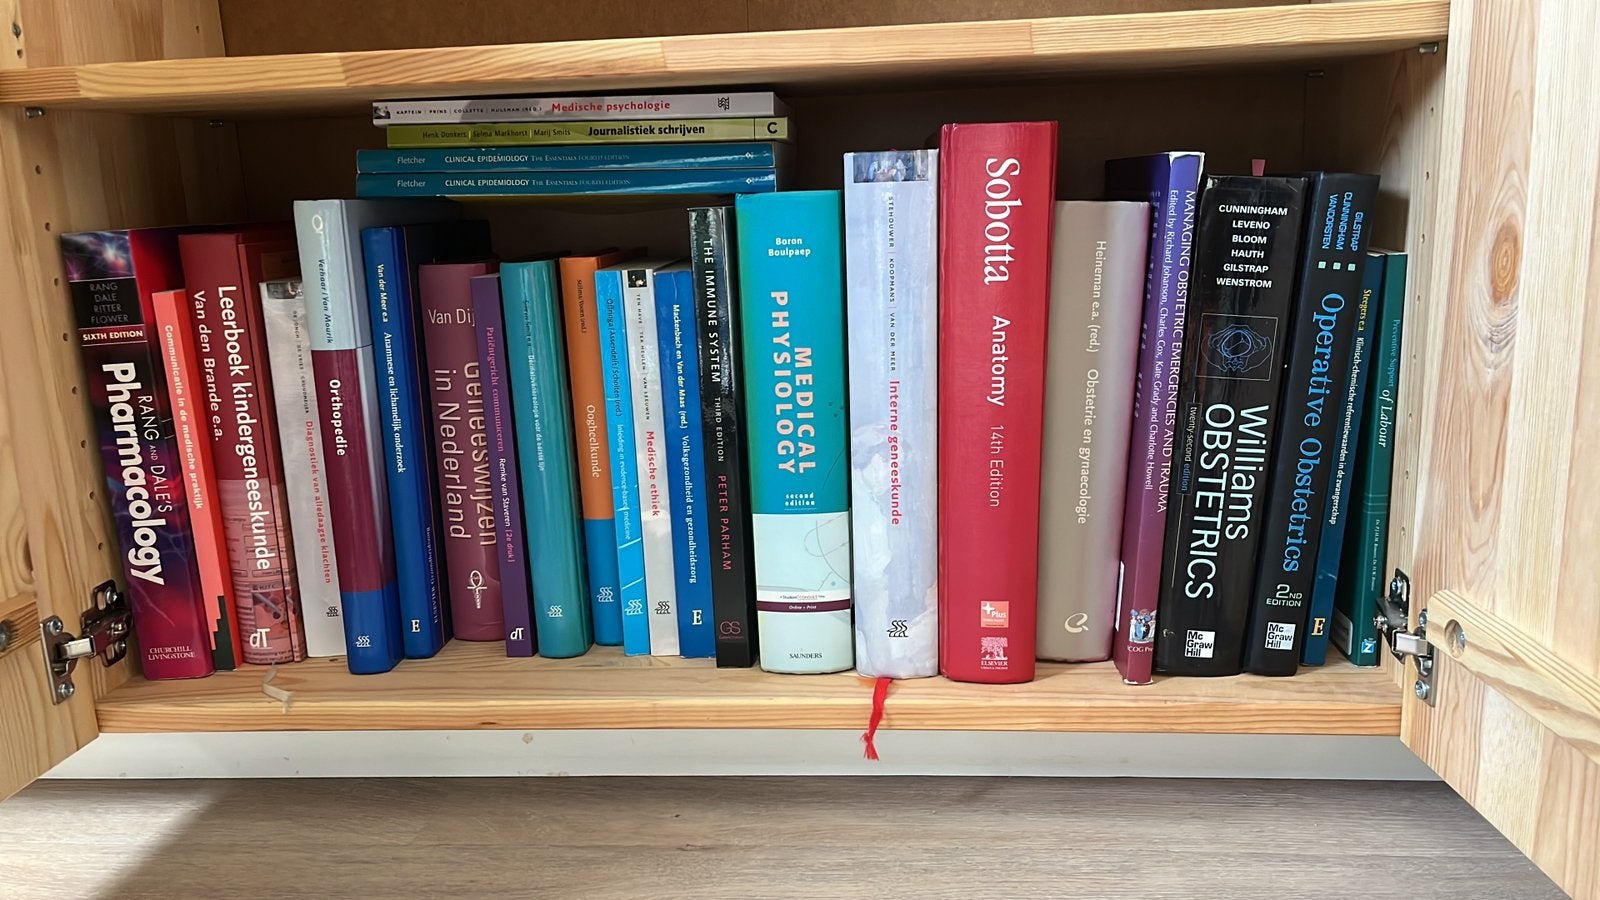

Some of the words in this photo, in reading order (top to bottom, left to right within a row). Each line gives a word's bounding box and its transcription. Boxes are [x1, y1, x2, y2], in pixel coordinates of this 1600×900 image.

[551, 102, 603, 112] Medische
[606, 101, 670, 115] psychologie
[494, 129, 528, 138] Markhorst
[588, 124, 656, 136] Journalistiek
[658, 124, 705, 136] schrijven
[767, 122, 778, 134] C
[396, 156, 426, 164] Fletcher
[477, 154, 528, 163] EPIDEMIOLOGY
[444, 179, 475, 187] CLINICAL
[478, 178, 529, 187] EPIDEMIOLOGY
[1168, 189, 1178, 216] Edited
[1218, 204, 1288, 216] CUNNINGHAM
[1336, 192, 1352, 250] CUNNINGHAM
[984, 158, 1022, 285] Sobotta
[1180, 190, 1196, 268] MANAGING
[1232, 220, 1270, 230] LEVENO
[1232, 234, 1268, 244] BLOOM
[1322, 194, 1338, 249] VANDORSTEN
[1350, 212, 1364, 251] GILSTRAP
[702, 238, 714, 264] THE
[768, 248, 811, 258] Boulpaep
[775, 237, 802, 246] Boron
[1164, 231, 1175, 262] Richard
[1231, 249, 1264, 259] HAUTH
[90, 282, 118, 292] RANG
[1092, 241, 1107, 298] Heineman
[1160, 265, 1173, 306] Johanson,
[1216, 278, 1272, 288] WENSTROM
[1223, 263, 1268, 274] GILSTRAP
[93, 304, 122, 312] RITTER
[94, 292, 117, 302] DALE
[194, 290, 206, 318] Van
[318, 258, 328, 290] Verhaar
[324, 314, 333, 344] Mourik
[704, 270, 718, 326] IMMUNE
[1092, 302, 1100, 321] e.a.
[1172, 270, 1189, 338] OBSTETRIC
[1359, 288, 1372, 320] Steegers
[91, 314, 128, 324] FLOWER
[218, 286, 250, 376] Leerboek
[428, 308, 452, 324] Van
[606, 298, 614, 327] Offringa
[610, 331, 618, 366] Assendelft
[1157, 306, 1168, 338] Charles
[82, 332, 108, 341] SIXTH
[110, 330, 143, 340] EDITION
[198, 325, 212, 352] den
[384, 332, 394, 375] Anamnese
[1086, 324, 1100, 352] (red.)
[1390, 319, 1400, 357] Preventive
[672, 304, 682, 349] Mackenbach
[678, 410, 688, 428] (red.)
[708, 332, 721, 382] SYSTEM
[988, 315, 1011, 406] Anatomy
[1154, 361, 1163, 380] Kate
[1304, 293, 1345, 427] Operative
[1348, 337, 1364, 402] Klinisch-chemische
[1387, 358, 1397, 387] Support
[204, 358, 222, 412] Brande
[434, 369, 457, 391] in
[770, 291, 796, 474] PHYSIOLOGY
[1084, 369, 1098, 426] Obstetrie
[1151, 381, 1162, 406] Grady
[1166, 341, 1182, 426] EMERGENCIES
[1379, 390, 1394, 402] of
[164, 325, 184, 394] Communicatie
[181, 424, 196, 470] medische
[189, 473, 204, 510] praktijk
[329, 379, 345, 456] Orthopedie
[390, 388, 402, 431] lichamelijk
[492, 389, 504, 452] communiceren
[794, 347, 816, 473] MEDICAL
[889, 380, 900, 432] Interne
[1150, 407, 1158, 422] and
[212, 415, 222, 440] e.a.
[586, 404, 602, 478] Oogheelkunde
[716, 426, 724, 462] EDITION
[990, 426, 1004, 454] 14th
[1083, 428, 1092, 444] en
[1148, 424, 1158, 461] Charlotte
[1162, 428, 1174, 457] AND
[1184, 406, 1198, 462] twenty-second
[1340, 402, 1354, 462] referentiewaarden
[1378, 406, 1393, 448] Labour
[138, 395, 160, 441] RANG
[150, 465, 172, 512] DALE'S
[304, 420, 320, 474] Diagnostiek
[394, 432, 406, 473] onderzoek
[646, 431, 656, 480] Medische
[102, 362, 167, 586] Pharmacology
[232, 382, 276, 570] kindergeneeskunde
[438, 403, 472, 538] Nederland
[499, 458, 507, 483] Remke
[620, 461, 629, 509] evidence-based
[680, 436, 694, 503] Volksgezondheid
[888, 436, 902, 525] geneeskunde
[990, 459, 1004, 507] Edition
[1076, 448, 1091, 524] gynaecologie
[1146, 462, 1155, 490] Howell
[1157, 462, 1172, 513] TRAUMA
[1181, 463, 1192, 491] edition
[1225, 405, 1270, 540] Williams
[650, 484, 660, 516] ethiek
[718, 475, 728, 512] PETER
[784, 498, 816, 506] edition
[1184, 404, 1236, 598] OBSTETRICS
[1283, 437, 1322, 572] Obstetrics
[1329, 479, 1342, 524] zwangerschap
[315, 496, 326, 543] alledaagse
[502, 498, 510, 528] Staveren
[686, 517, 698, 584] gezondheidszorg
[720, 518, 731, 570] PARHAM
[320, 546, 330, 584] klachten
[1266, 598, 1302, 607] EDITION
[1186, 640, 1213, 650] Graw
[1188, 631, 1203, 640] Mc
[1266, 640, 1282, 648] Hill
[1267, 632, 1293, 641] Graw
[1268, 623, 1284, 632] Mc
[148, 651, 196, 660] LIVINGSTONE
[150, 645, 192, 654] CHURCHILL
[1186, 648, 1201, 657] Hill
